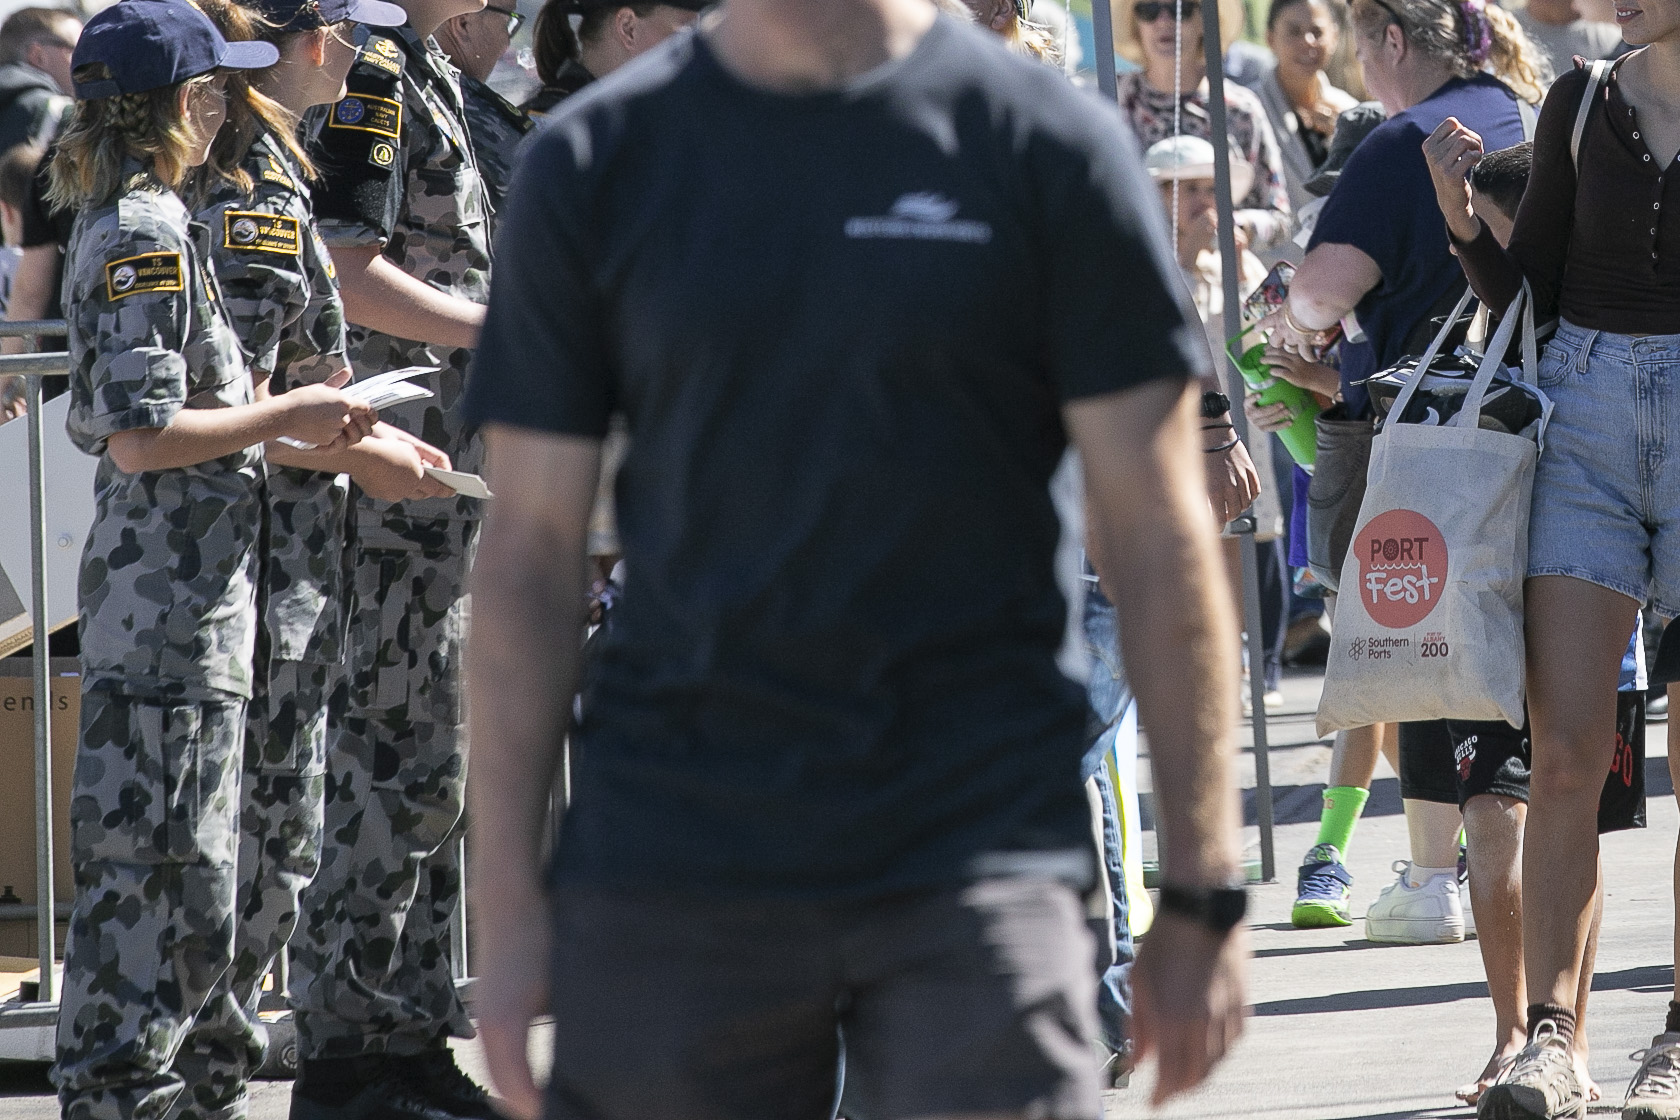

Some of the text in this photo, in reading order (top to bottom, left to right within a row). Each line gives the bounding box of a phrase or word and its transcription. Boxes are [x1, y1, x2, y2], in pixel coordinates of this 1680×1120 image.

[367, 104, 397, 116] AUSTRALIAN
[370, 117, 390, 127] CADETS
[152, 258, 163, 267] TS
[138, 267, 178, 277] VANCOUVER
[1370, 537, 1429, 562] PORT
[1365, 565, 1439, 604] Fest
[1368, 637, 1410, 648] Southern
[1368, 649, 1391, 660] Ports
[1421, 642, 1449, 658] 200
